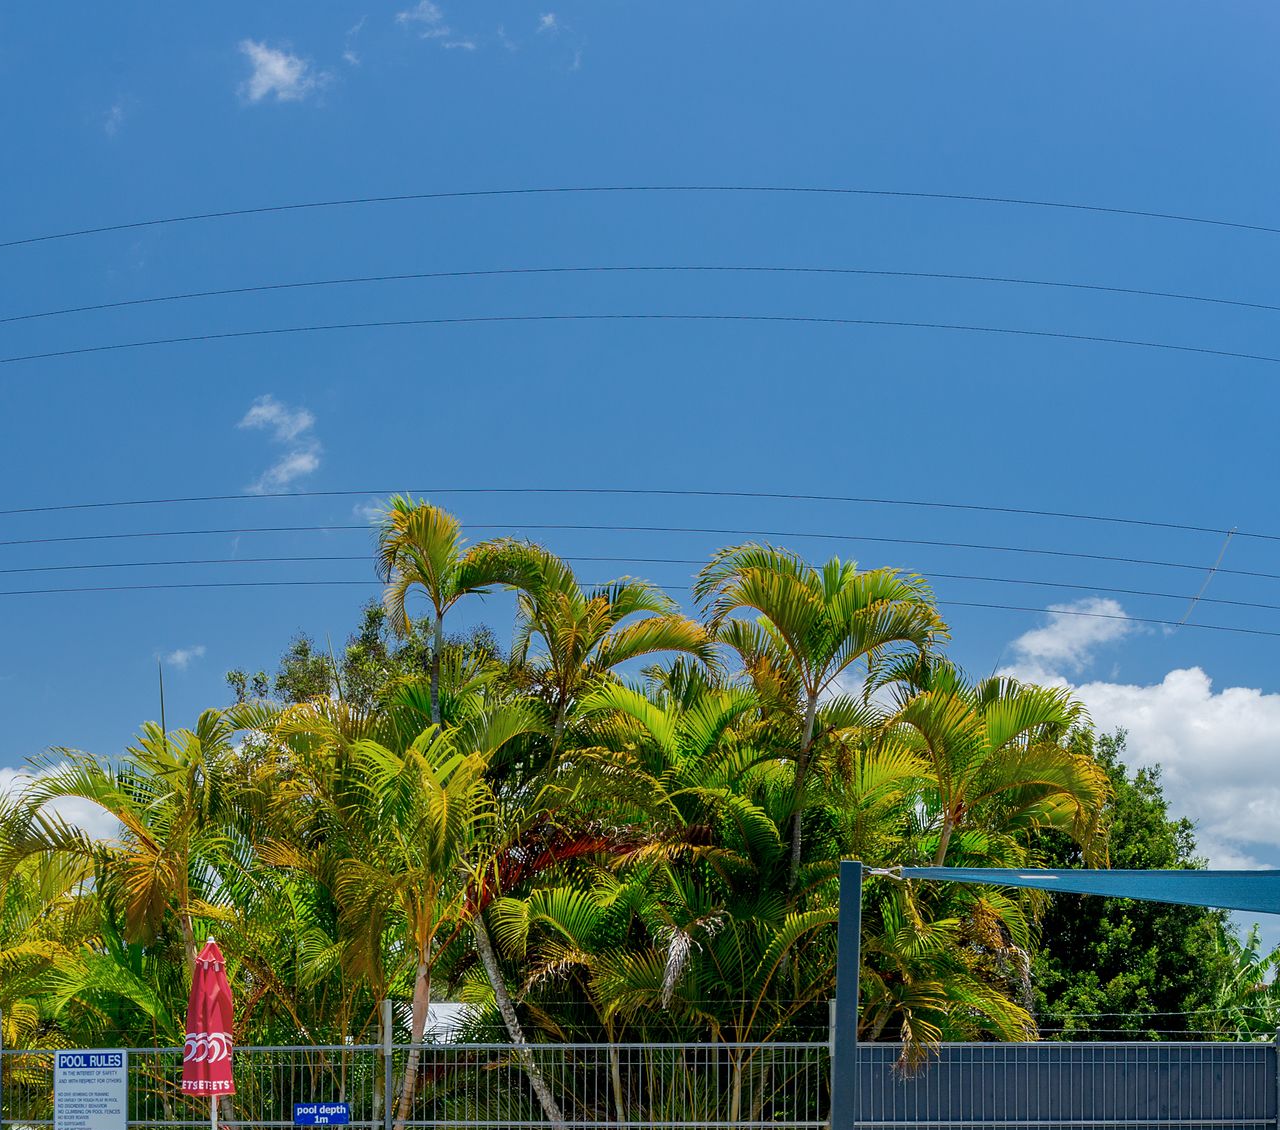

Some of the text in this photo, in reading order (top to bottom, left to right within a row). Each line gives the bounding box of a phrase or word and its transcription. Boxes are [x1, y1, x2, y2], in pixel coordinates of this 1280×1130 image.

[60, 1055, 121, 1067] POOL RULES
[297, 1105, 346, 1116] pool depth
[314, 1115, 328, 1124] 1m
